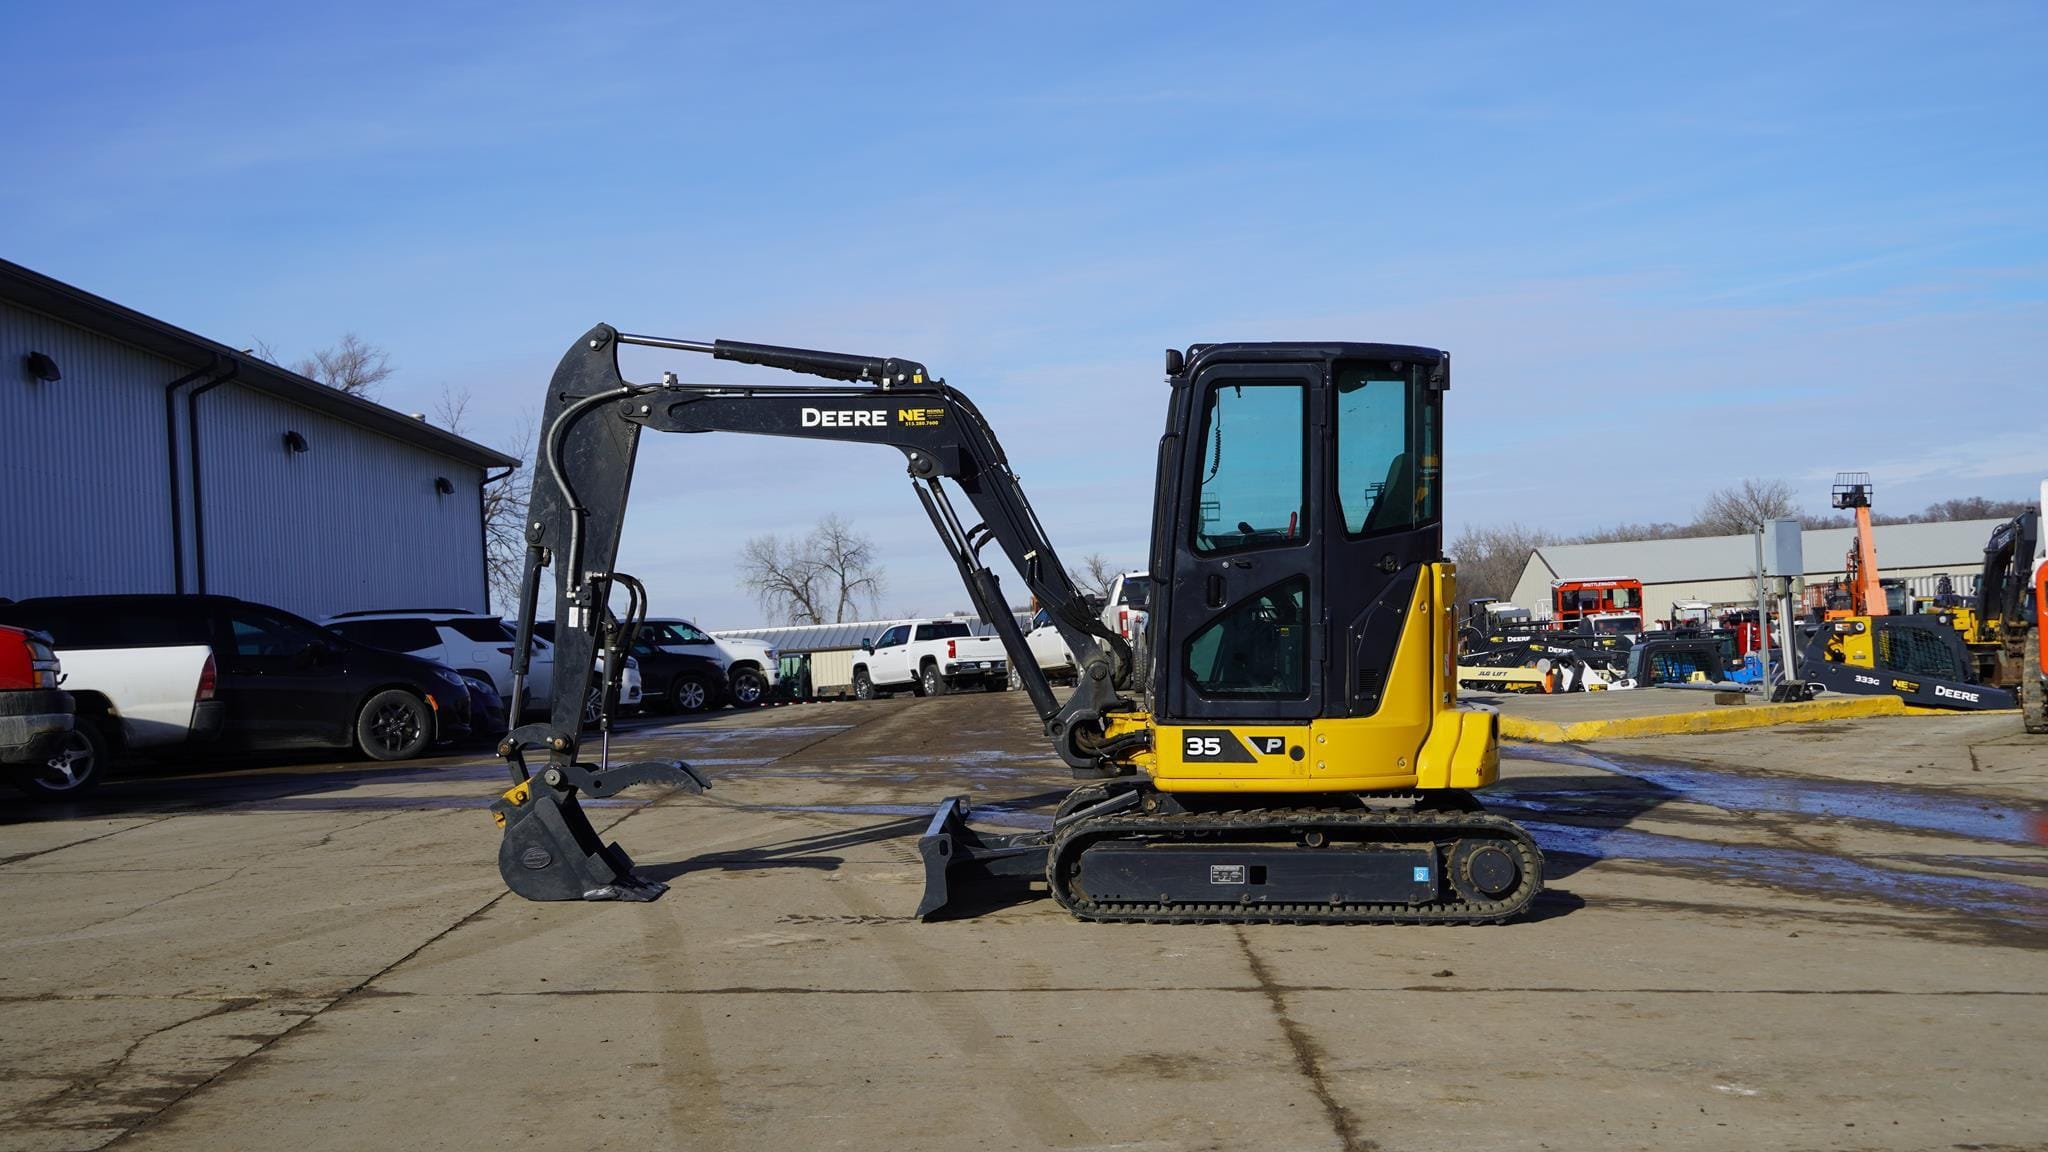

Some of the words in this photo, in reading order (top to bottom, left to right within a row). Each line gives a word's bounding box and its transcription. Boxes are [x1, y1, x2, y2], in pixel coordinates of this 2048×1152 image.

[801, 407, 888, 427] DEERE
[898, 409, 926, 421] NE
[1854, 675, 1880, 686] 333G
[1892, 679, 1909, 689] NE
[1935, 685, 1980, 703] DEERE
[1186, 737, 1221, 756] 35
[1266, 738, 1282, 753] P
